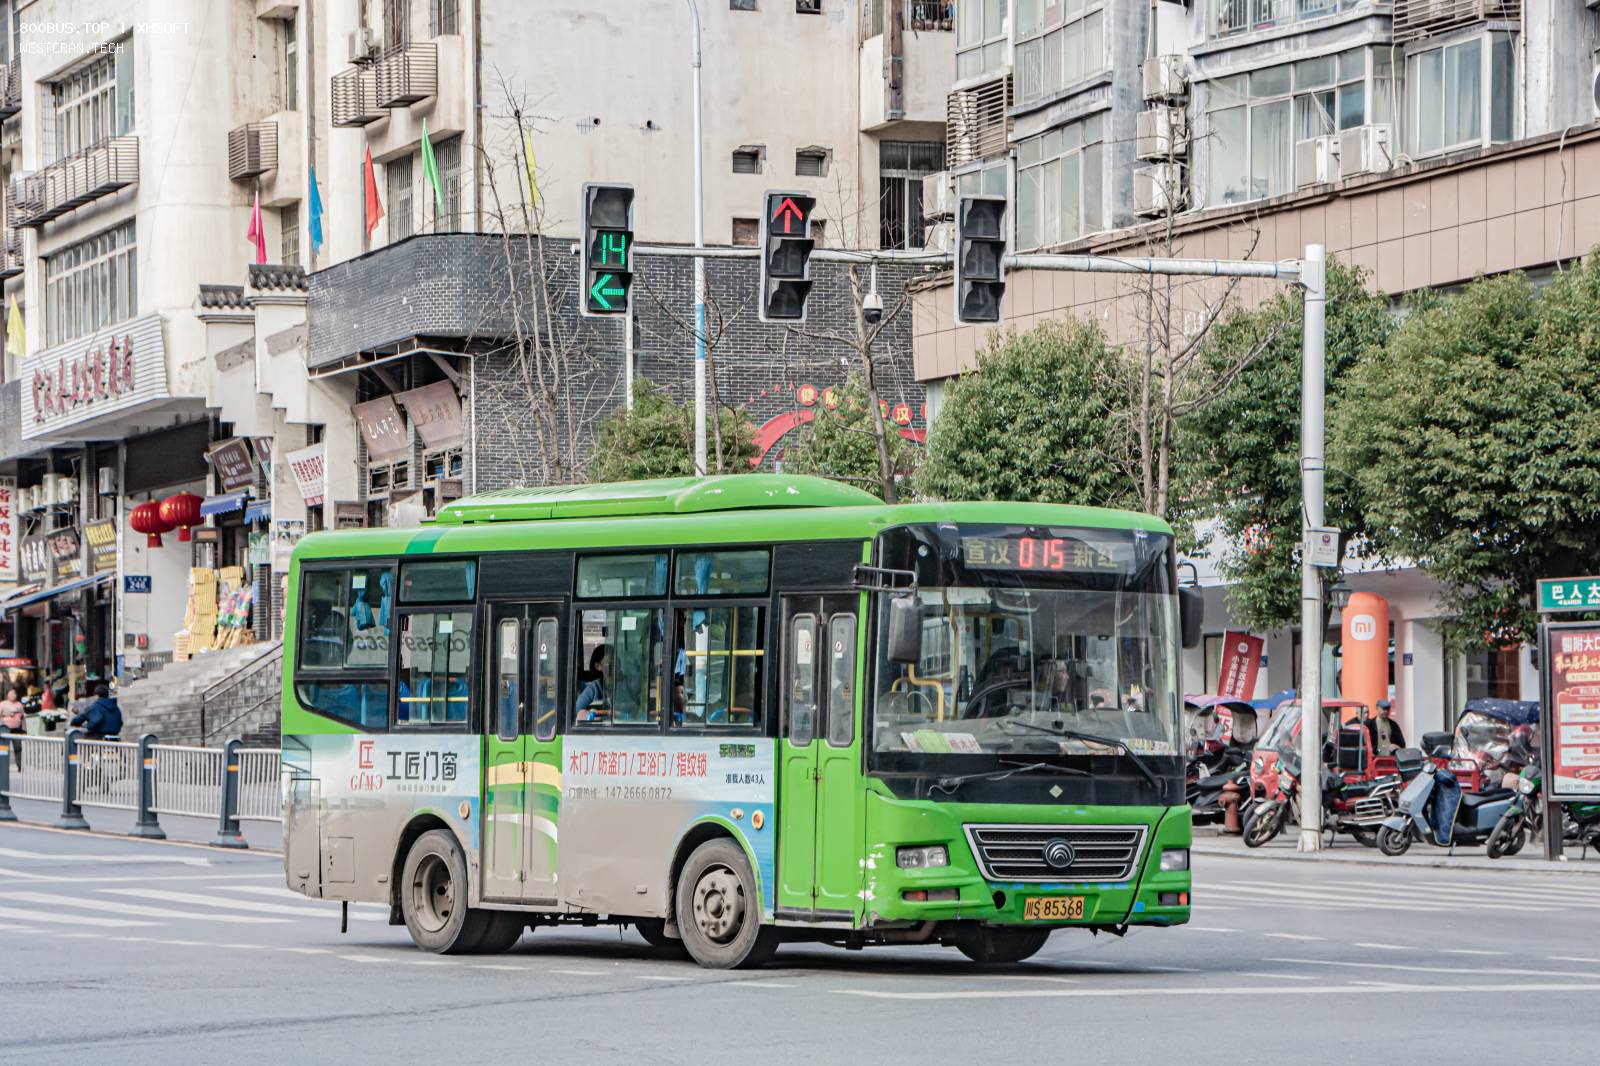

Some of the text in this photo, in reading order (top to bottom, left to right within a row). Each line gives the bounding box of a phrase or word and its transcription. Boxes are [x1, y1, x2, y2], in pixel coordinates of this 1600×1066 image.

[602, 233, 626, 266] 14
[966, 538, 1012, 566] 宣汉
[1018, 537, 1065, 570] 015
[386, 751, 458, 781] 工匠门窗
